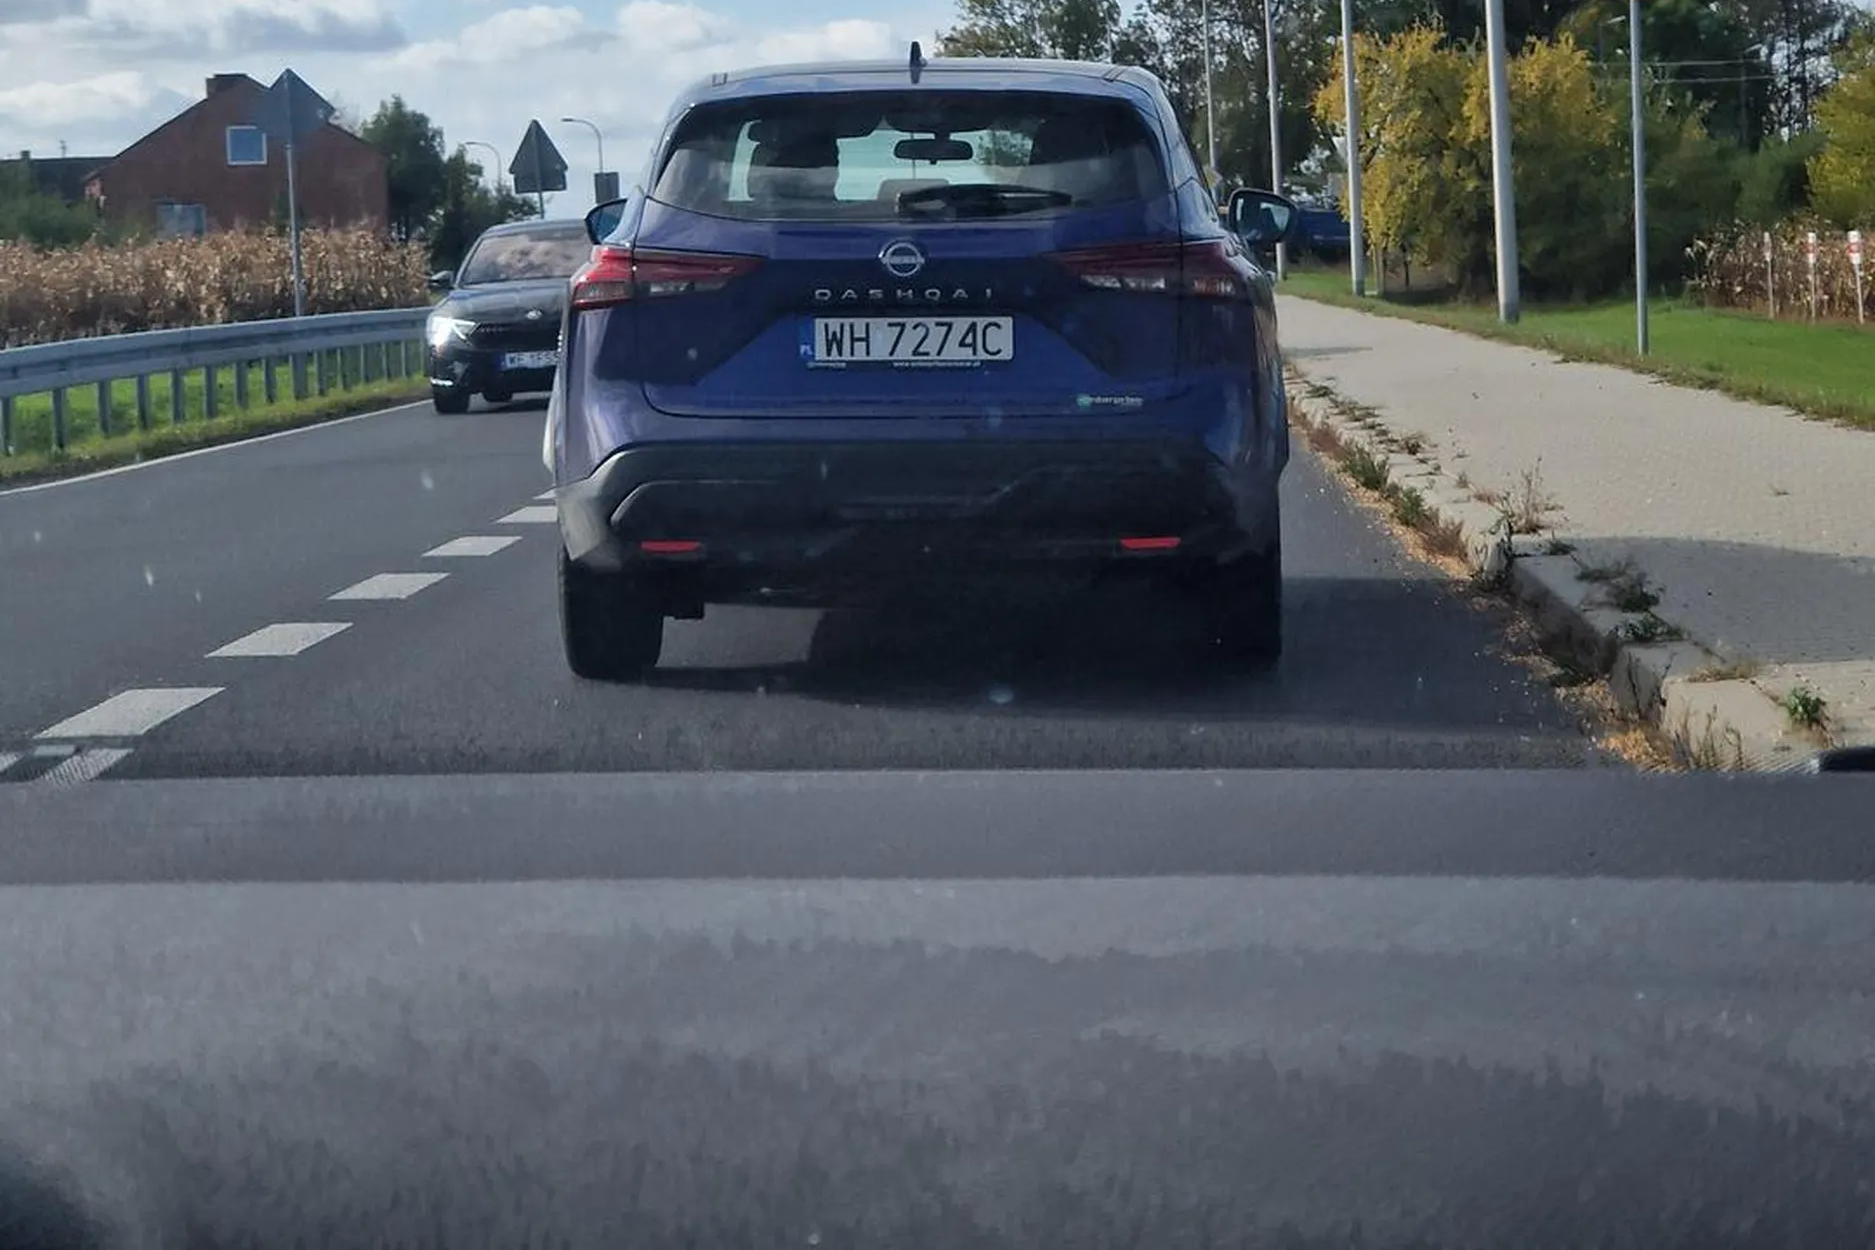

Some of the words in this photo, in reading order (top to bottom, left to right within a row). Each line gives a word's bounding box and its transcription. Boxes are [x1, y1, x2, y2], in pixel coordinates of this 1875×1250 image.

[814, 287, 994, 301] QASHQAI
[823, 322, 872, 358] WH
[886, 321, 1004, 357] 7274C
